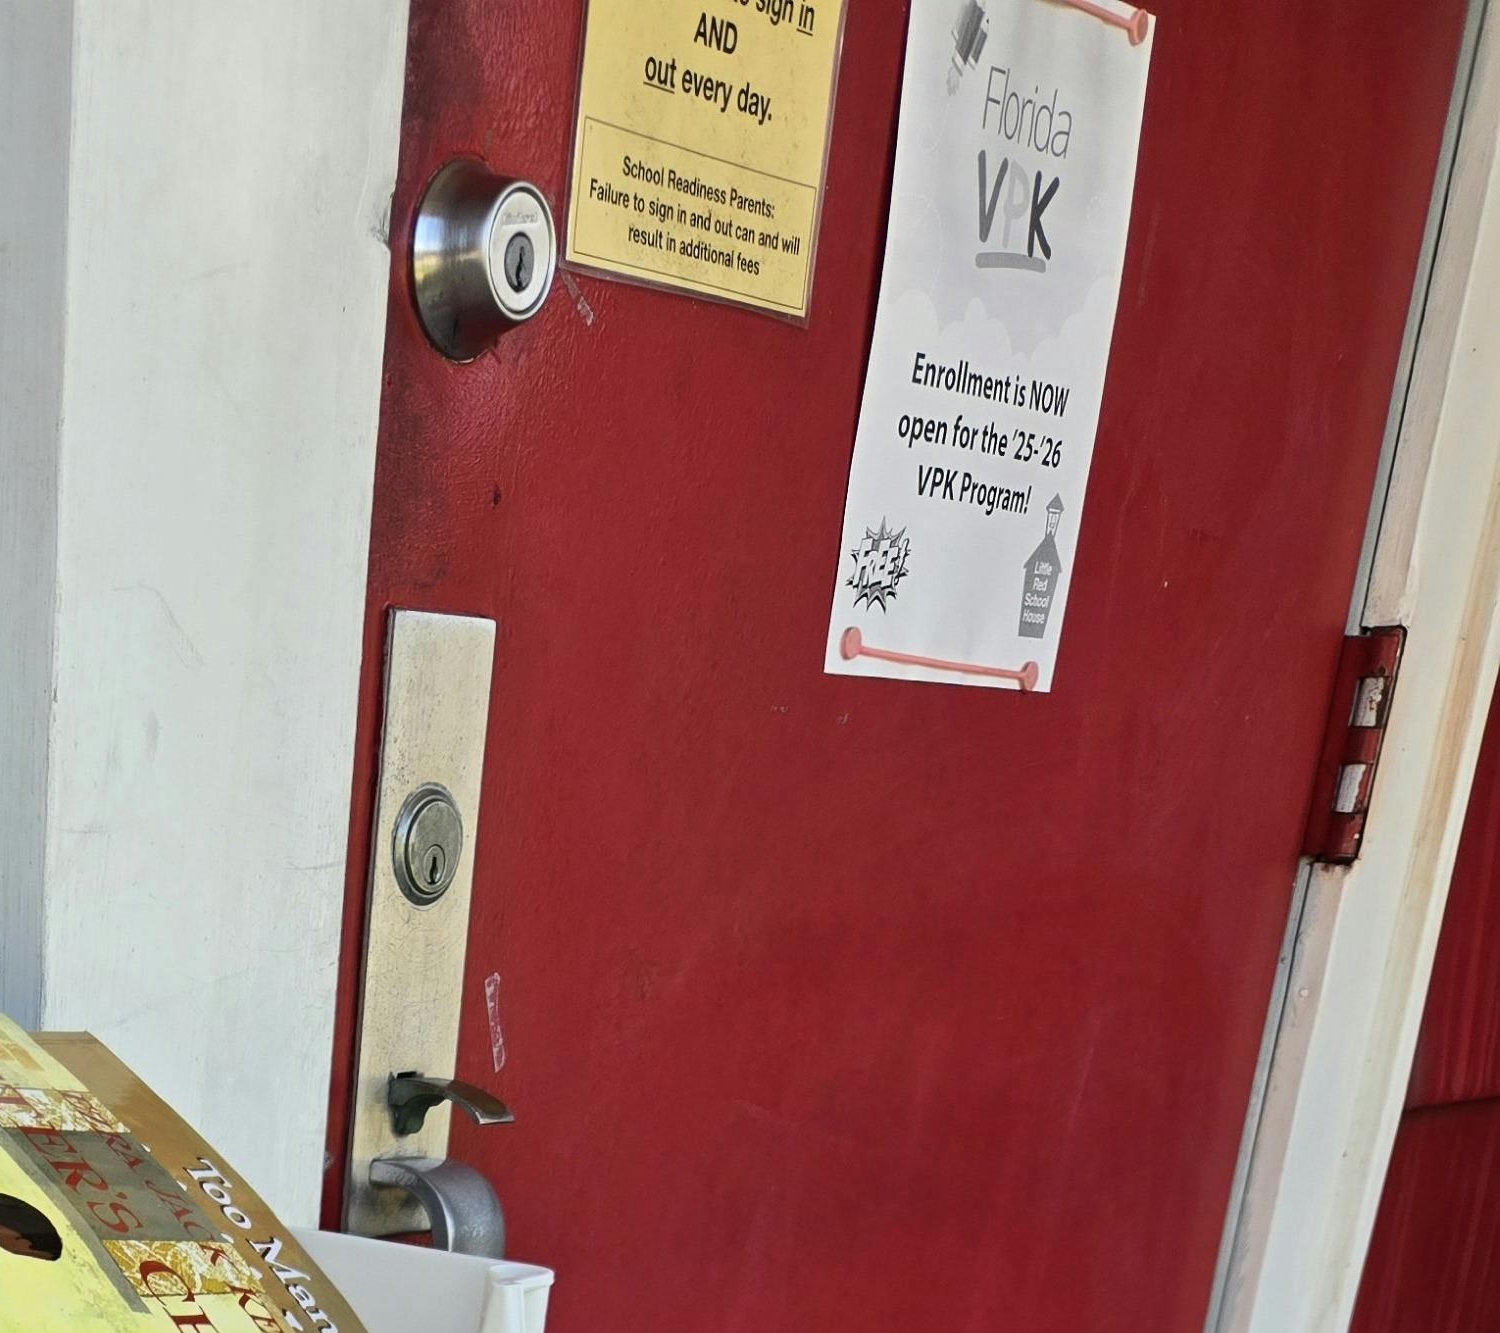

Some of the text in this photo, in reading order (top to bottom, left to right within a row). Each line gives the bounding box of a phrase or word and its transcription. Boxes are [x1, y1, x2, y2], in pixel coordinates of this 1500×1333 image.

[694, 13, 738, 54] AND
[799, 3, 815, 31] in
[644, 56, 772, 125] out every day.
[982, 66, 1073, 160] Florida
[622, 156, 775, 218] School Readiness Parents:
[978, 150, 1060, 260] VPK
[589, 178, 800, 255] Failure to sign in and out can and will
[628, 225, 760, 276] result in additional fees
[911, 352, 1070, 417] Enrollment is NOW
[898, 414, 1062, 469] open for the '25-'26
[917, 464, 1032, 516] VPK Program!
[852, 537, 910, 589] FREE!
[1032, 577, 1049, 593] Red
[1034, 561, 1053, 577] Little
[1022, 609, 1045, 625] House
[1024, 593, 1050, 609] School
[52, 1086, 148, 1173] EZRA
[145, 1178, 229, 1268] JACK
[183, 1156, 253, 1230] Too
